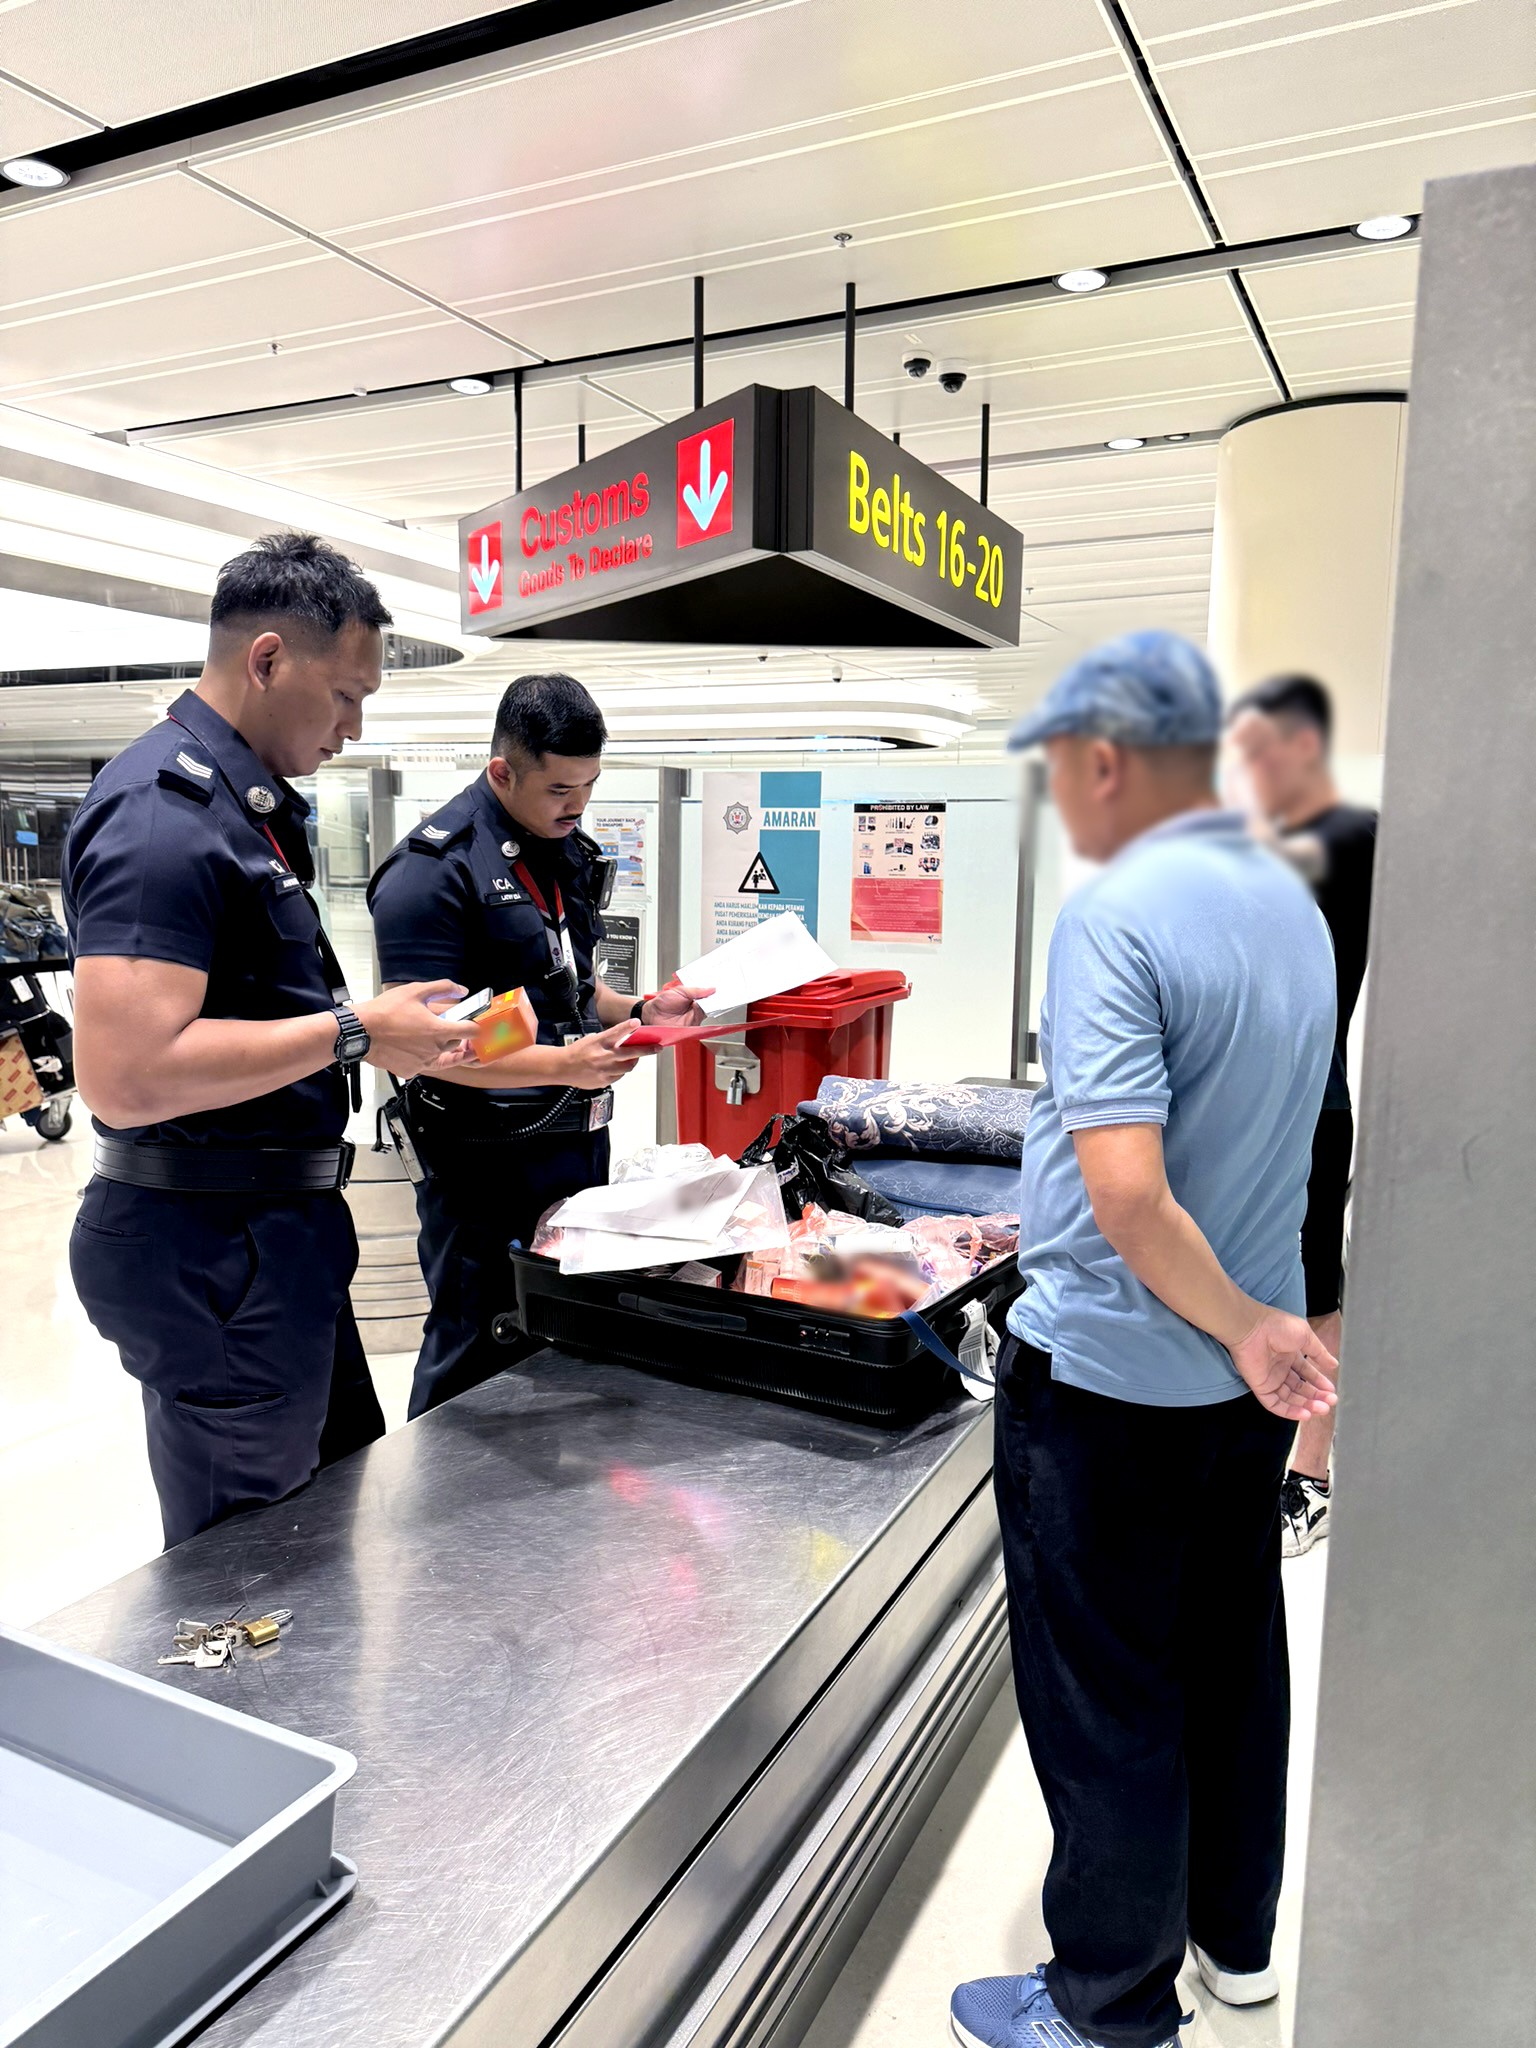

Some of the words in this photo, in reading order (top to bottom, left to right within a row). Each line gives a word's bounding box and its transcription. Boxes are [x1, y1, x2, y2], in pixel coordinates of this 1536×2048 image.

[520, 472, 650, 560] Customs
[849, 450, 926, 567] Belts
[936, 510, 1003, 608] 16-20
[518, 563, 565, 598] Goods
[567, 552, 586, 581] To
[589, 533, 653, 575] Declare
[763, 811, 816, 827] AMARAN
[492, 878, 515, 891] ICA
